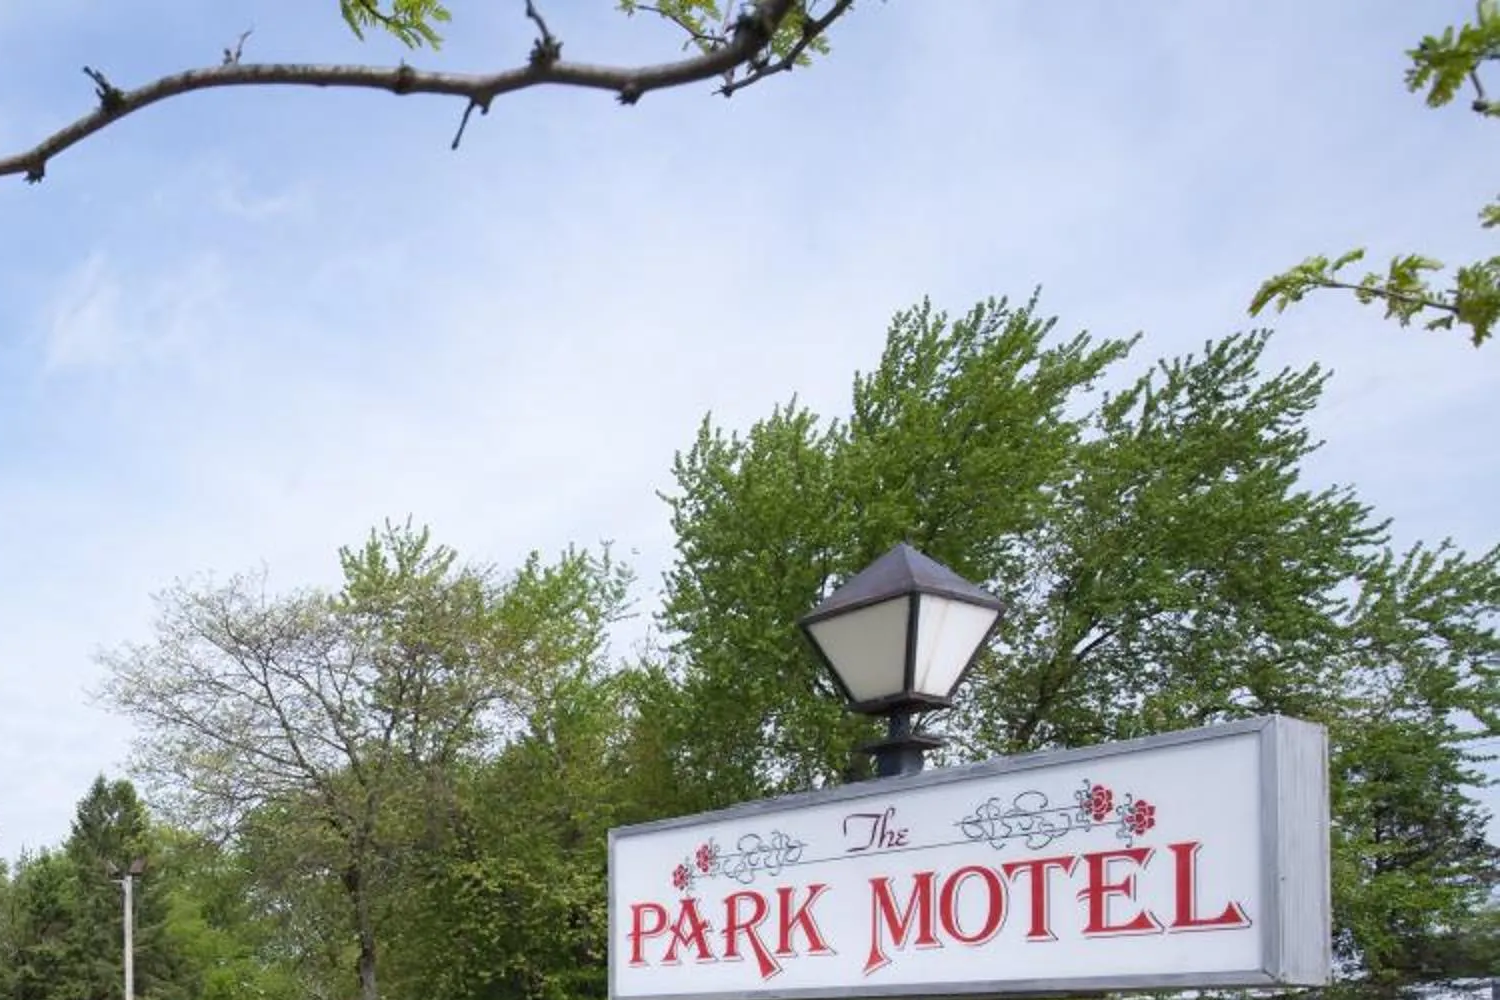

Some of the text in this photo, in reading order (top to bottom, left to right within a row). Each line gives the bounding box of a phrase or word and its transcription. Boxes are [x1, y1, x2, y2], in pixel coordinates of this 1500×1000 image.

[842, 806, 911, 853] The
[628, 841, 1253, 980] PARK MOTEL
